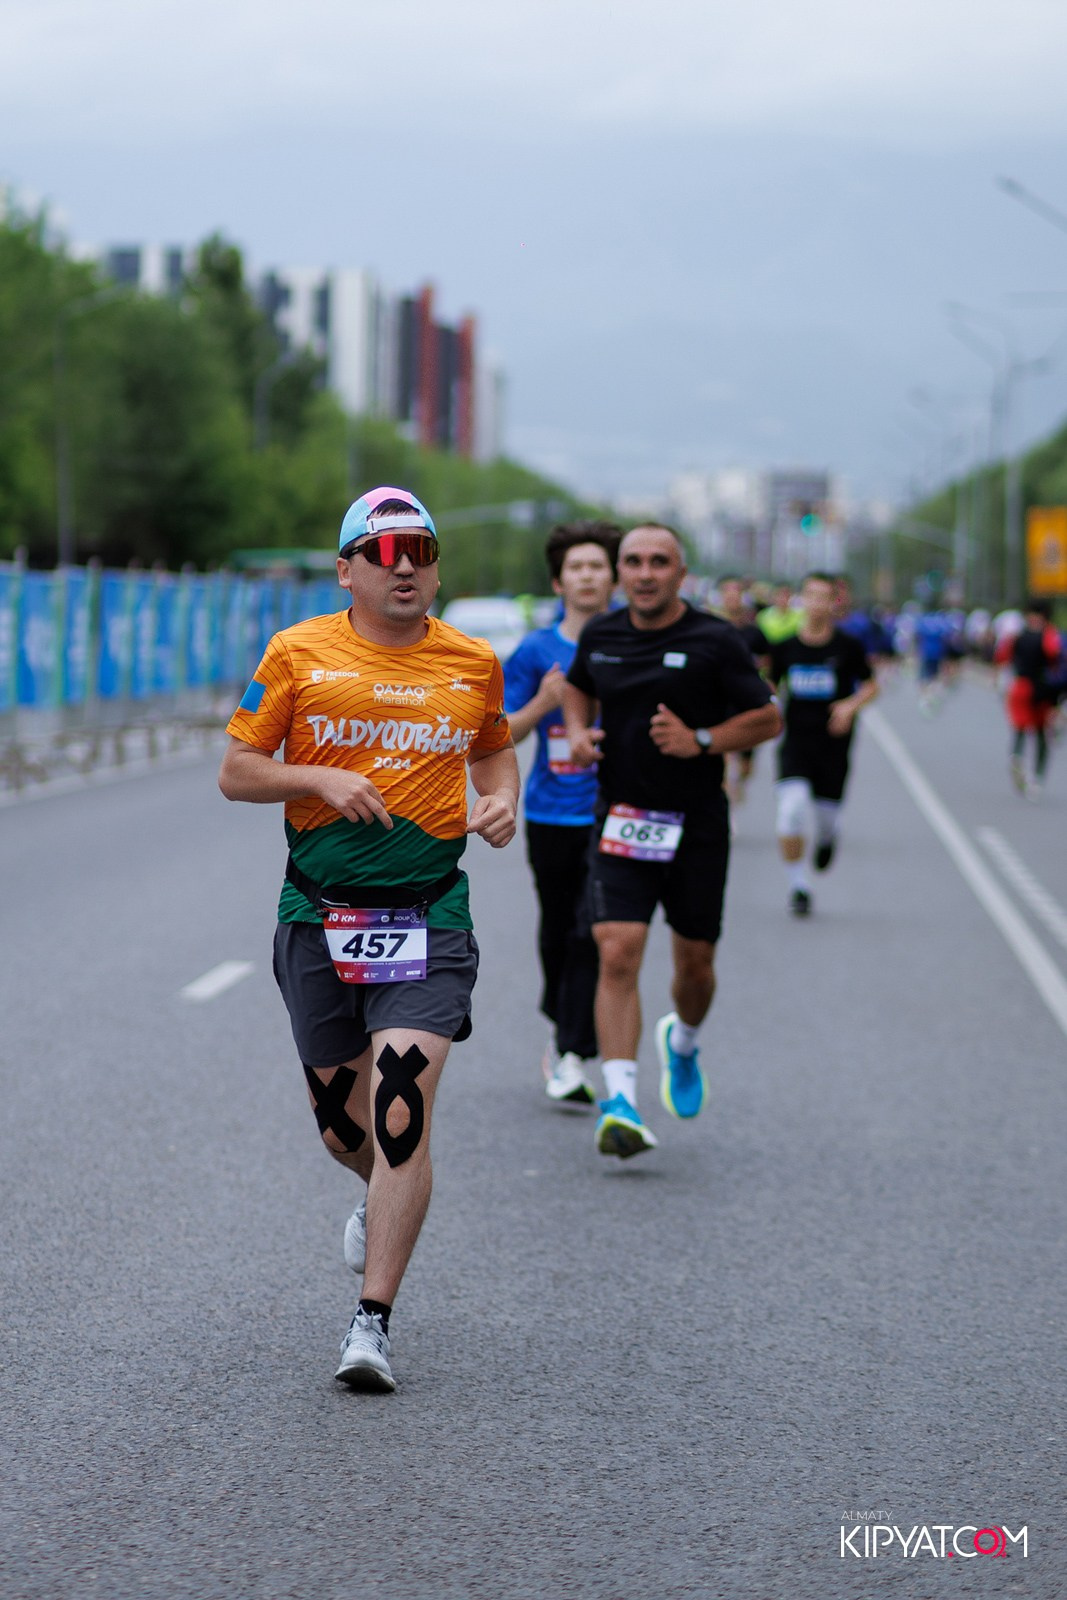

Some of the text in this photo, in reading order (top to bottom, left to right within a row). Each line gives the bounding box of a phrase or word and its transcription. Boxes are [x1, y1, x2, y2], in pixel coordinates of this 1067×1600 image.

[373, 683, 425, 699] QAZAQ
[374, 695, 426, 706] marathon
[373, 756, 411, 770] 2024
[620, 822, 667, 844] 065
[328, 912, 339, 922] 10
[341, 933, 408, 958] 457
